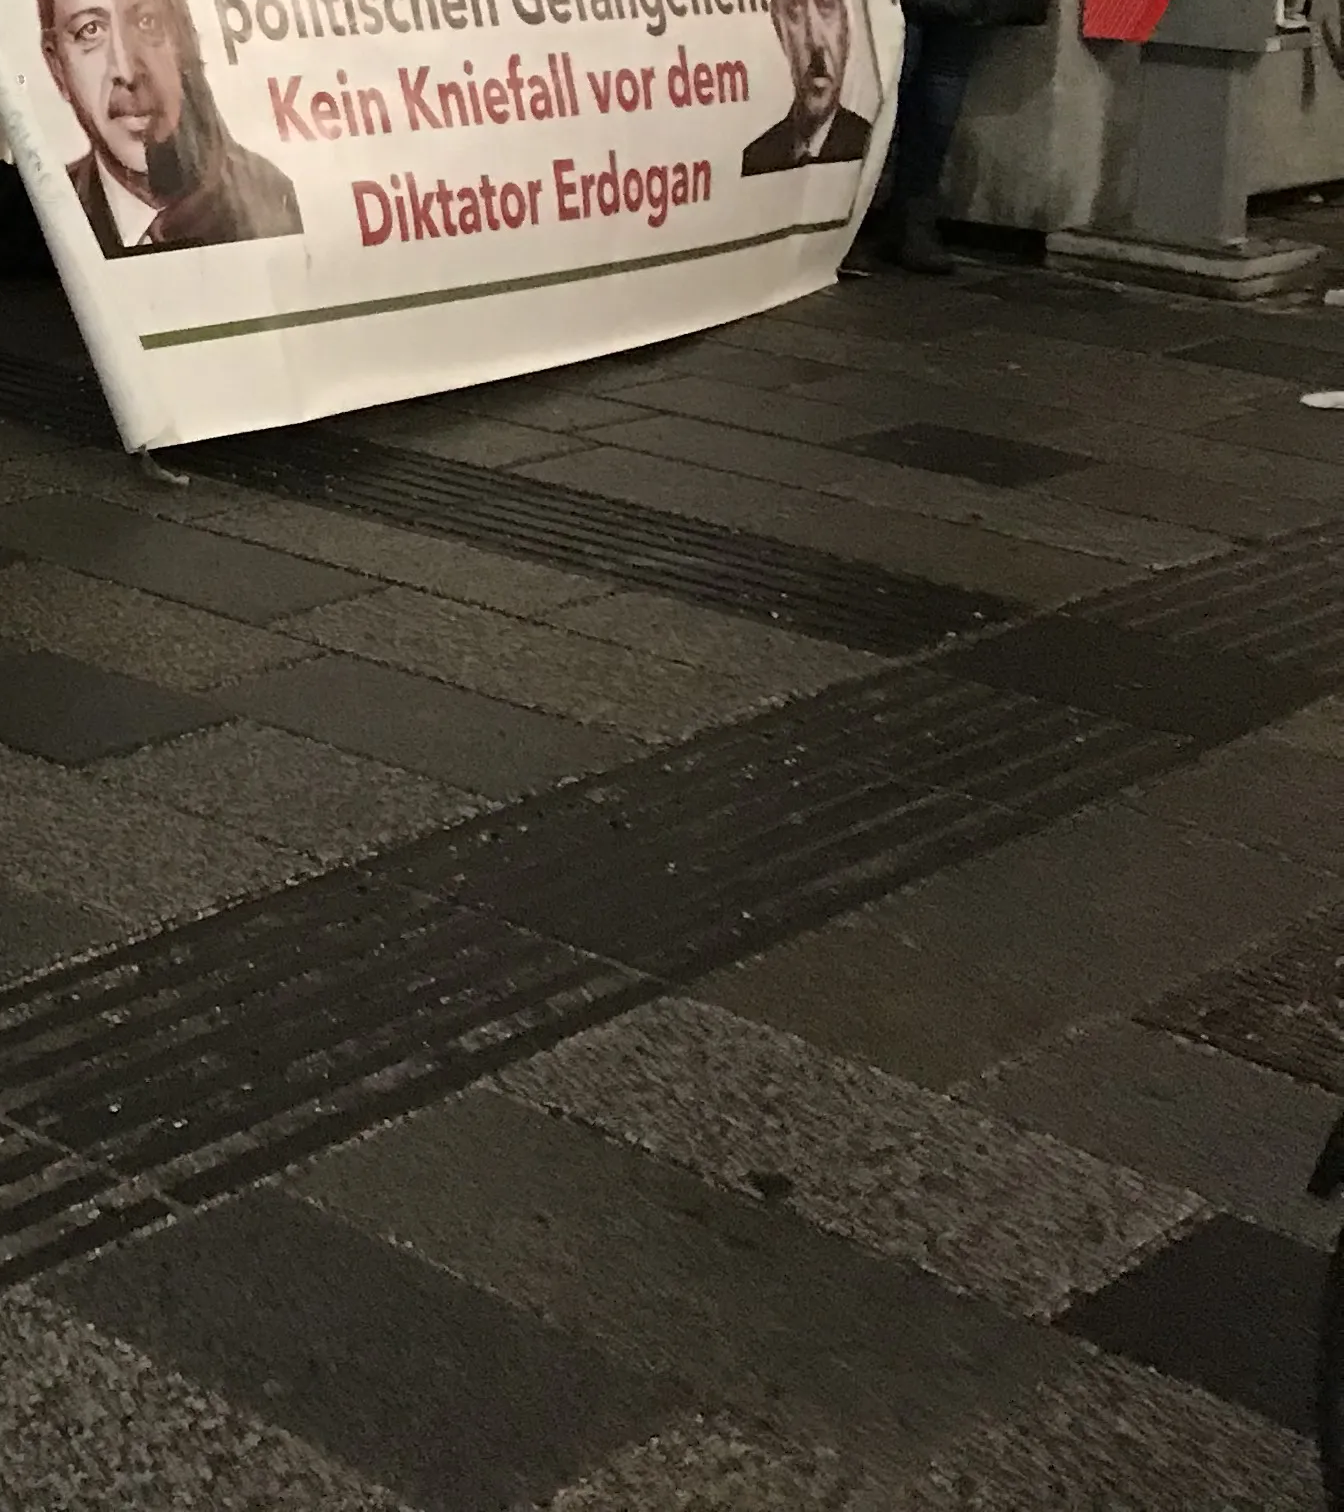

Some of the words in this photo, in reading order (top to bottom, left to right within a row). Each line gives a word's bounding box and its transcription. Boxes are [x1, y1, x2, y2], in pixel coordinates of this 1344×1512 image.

[267, 71, 392, 144] Kein
[398, 51, 580, 132] Kniefall
[585, 56, 660, 112] vor
[667, 44, 750, 107] dem
[352, 174, 543, 247] Diktator
[554, 148, 712, 229] Erdogan
